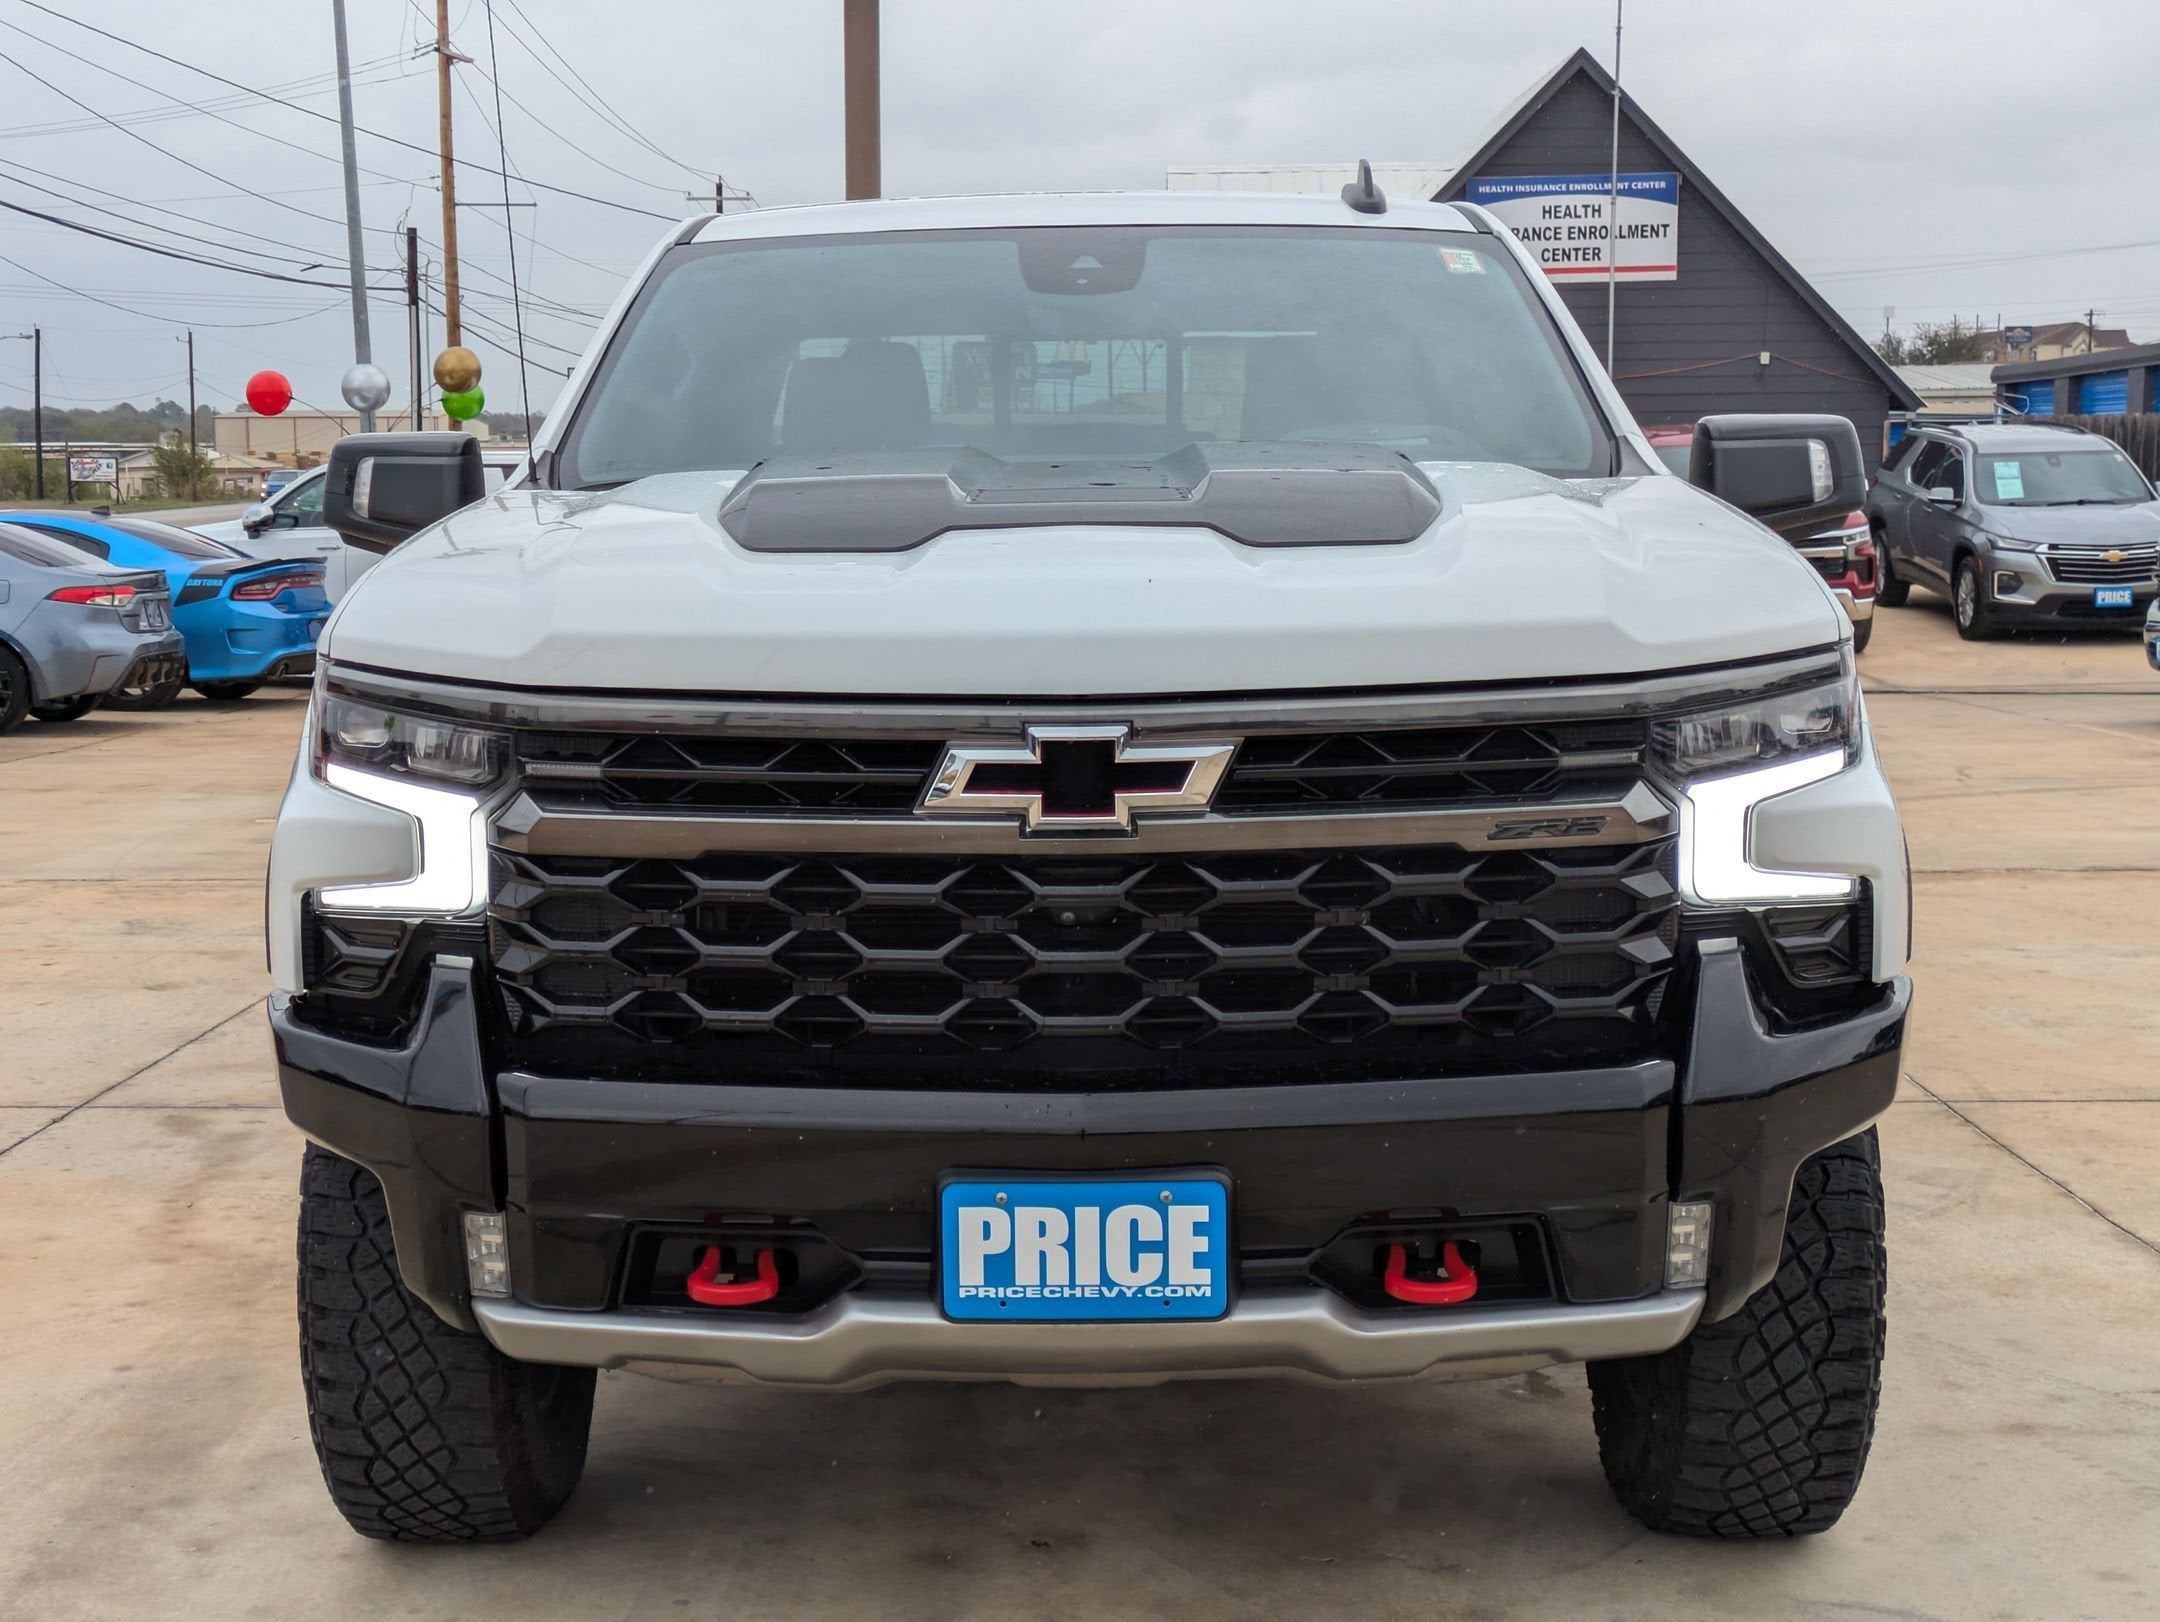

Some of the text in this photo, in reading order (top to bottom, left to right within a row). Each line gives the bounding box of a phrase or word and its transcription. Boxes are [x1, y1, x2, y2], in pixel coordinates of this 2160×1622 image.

[1479, 181, 1666, 193] HEALTH INSURANCE ENROLLMNT CENTER
[1542, 204, 1602, 219] HEALTH
[1510, 226, 1562, 241] RANCE
[1541, 247, 1602, 262] CENTER
[186, 578, 224, 586] DAYTONA
[2097, 591, 2131, 602] PRICE
[958, 1204, 1212, 1287] PRICE
[959, 1286, 1212, 1298] PRICECHEVY.COM
